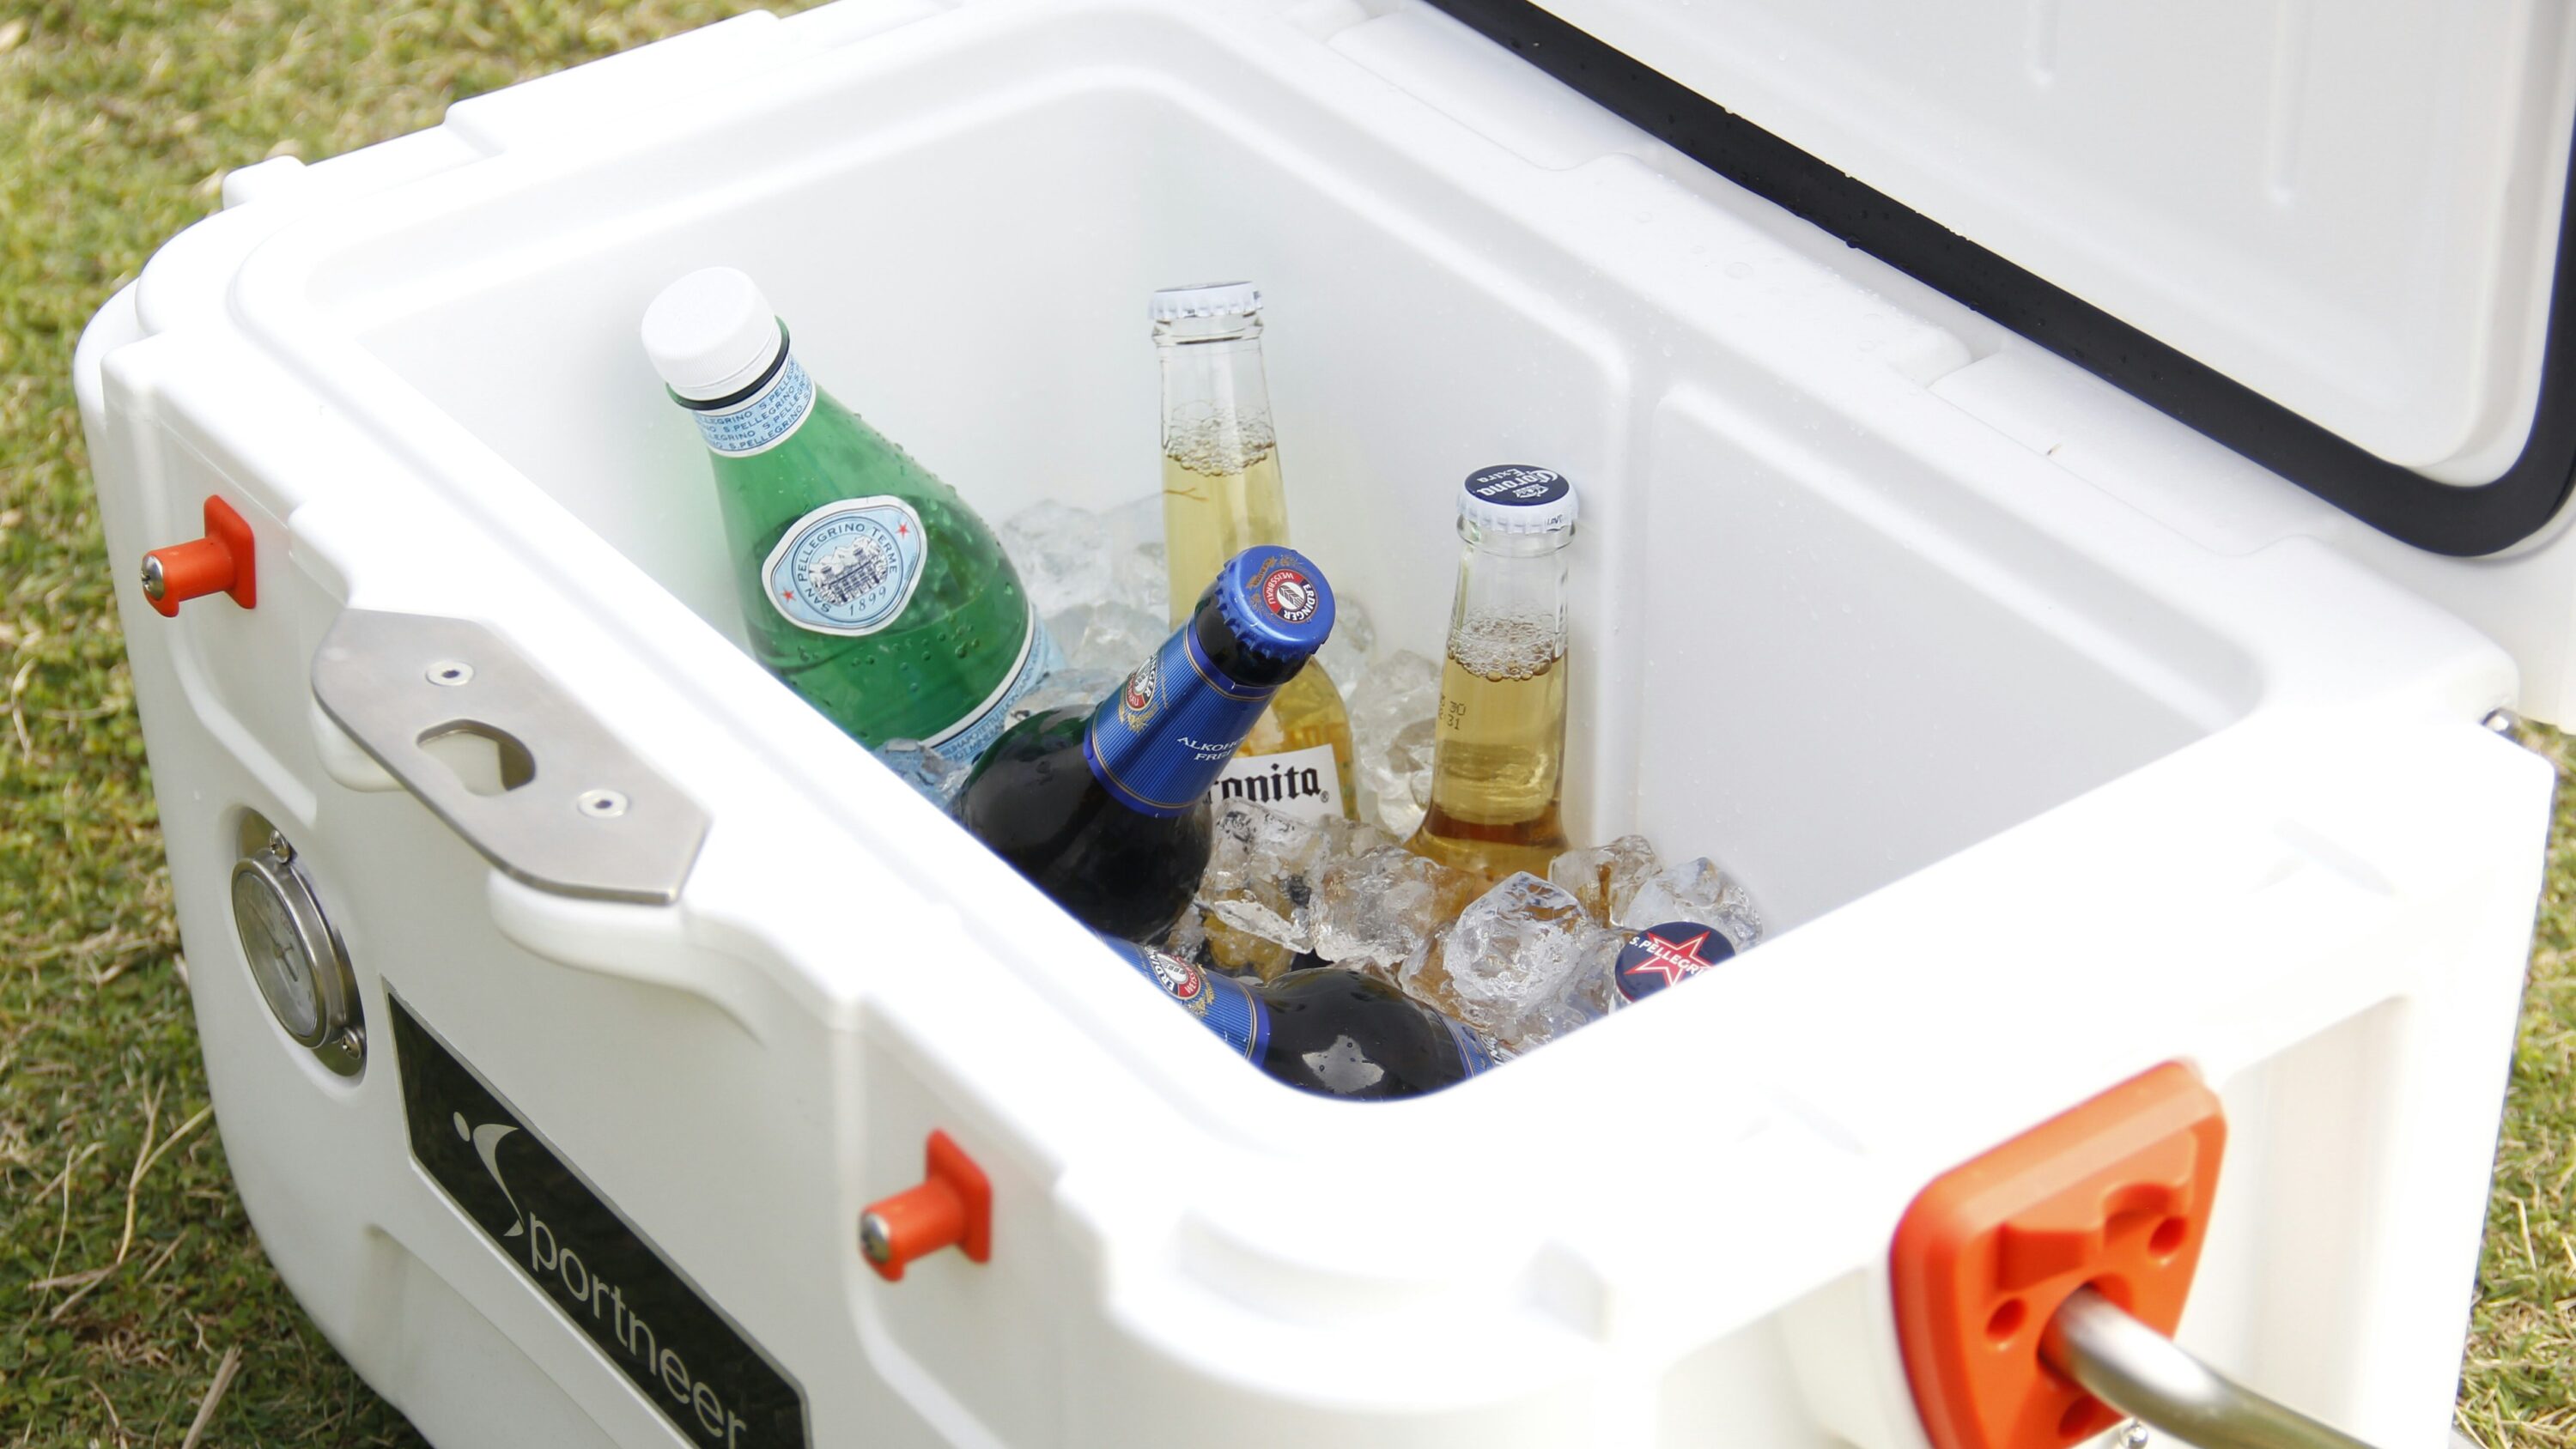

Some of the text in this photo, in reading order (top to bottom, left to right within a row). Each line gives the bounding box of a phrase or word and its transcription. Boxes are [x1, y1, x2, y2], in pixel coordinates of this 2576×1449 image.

[723, 385, 795, 433] S.PELLEGRINO
[729, 404, 803, 449] S.PELLEGRINO
[1477, 469, 1526, 482] Extra
[1477, 470, 1558, 496] Corona
[798, 523, 897, 613] SAN PELLEGRINO TERME
[850, 586, 886, 616] 1899
[1284, 584, 1315, 621] ERDINGER
[1448, 713, 1460, 731] 31
[1177, 734, 1245, 751] ALKOH
[1194, 749, 1232, 761] FREI
[1206, 762, 1322, 803] ronita
[453, 1112, 747, 1449] Sportneer
